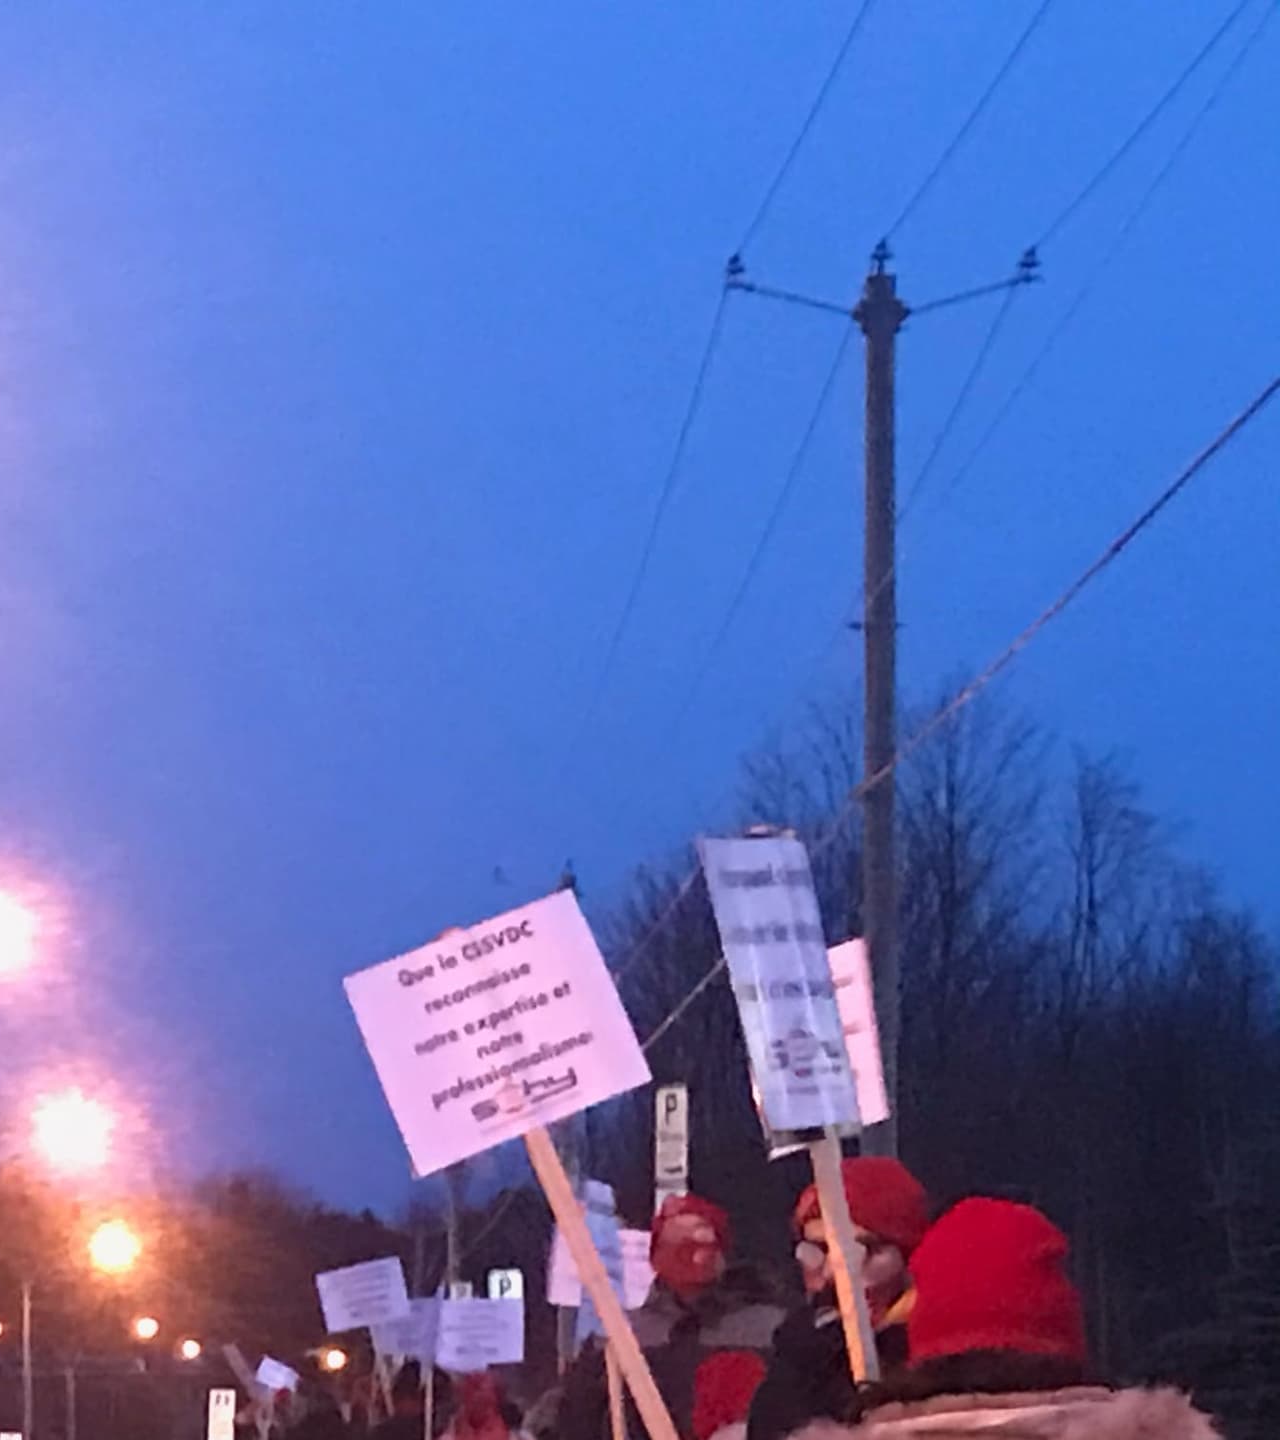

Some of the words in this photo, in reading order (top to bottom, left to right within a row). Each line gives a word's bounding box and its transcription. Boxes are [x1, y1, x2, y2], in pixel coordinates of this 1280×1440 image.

[398, 965, 434, 987] Que
[437, 953, 458, 970] le
[461, 920, 534, 961] CSSVDC
[414, 1029, 458, 1055] notre
[464, 992, 549, 1035] expertise
[553, 981, 571, 999] et
[424, 963, 531, 1014] reconnaisse
[477, 1031, 523, 1059] notre
